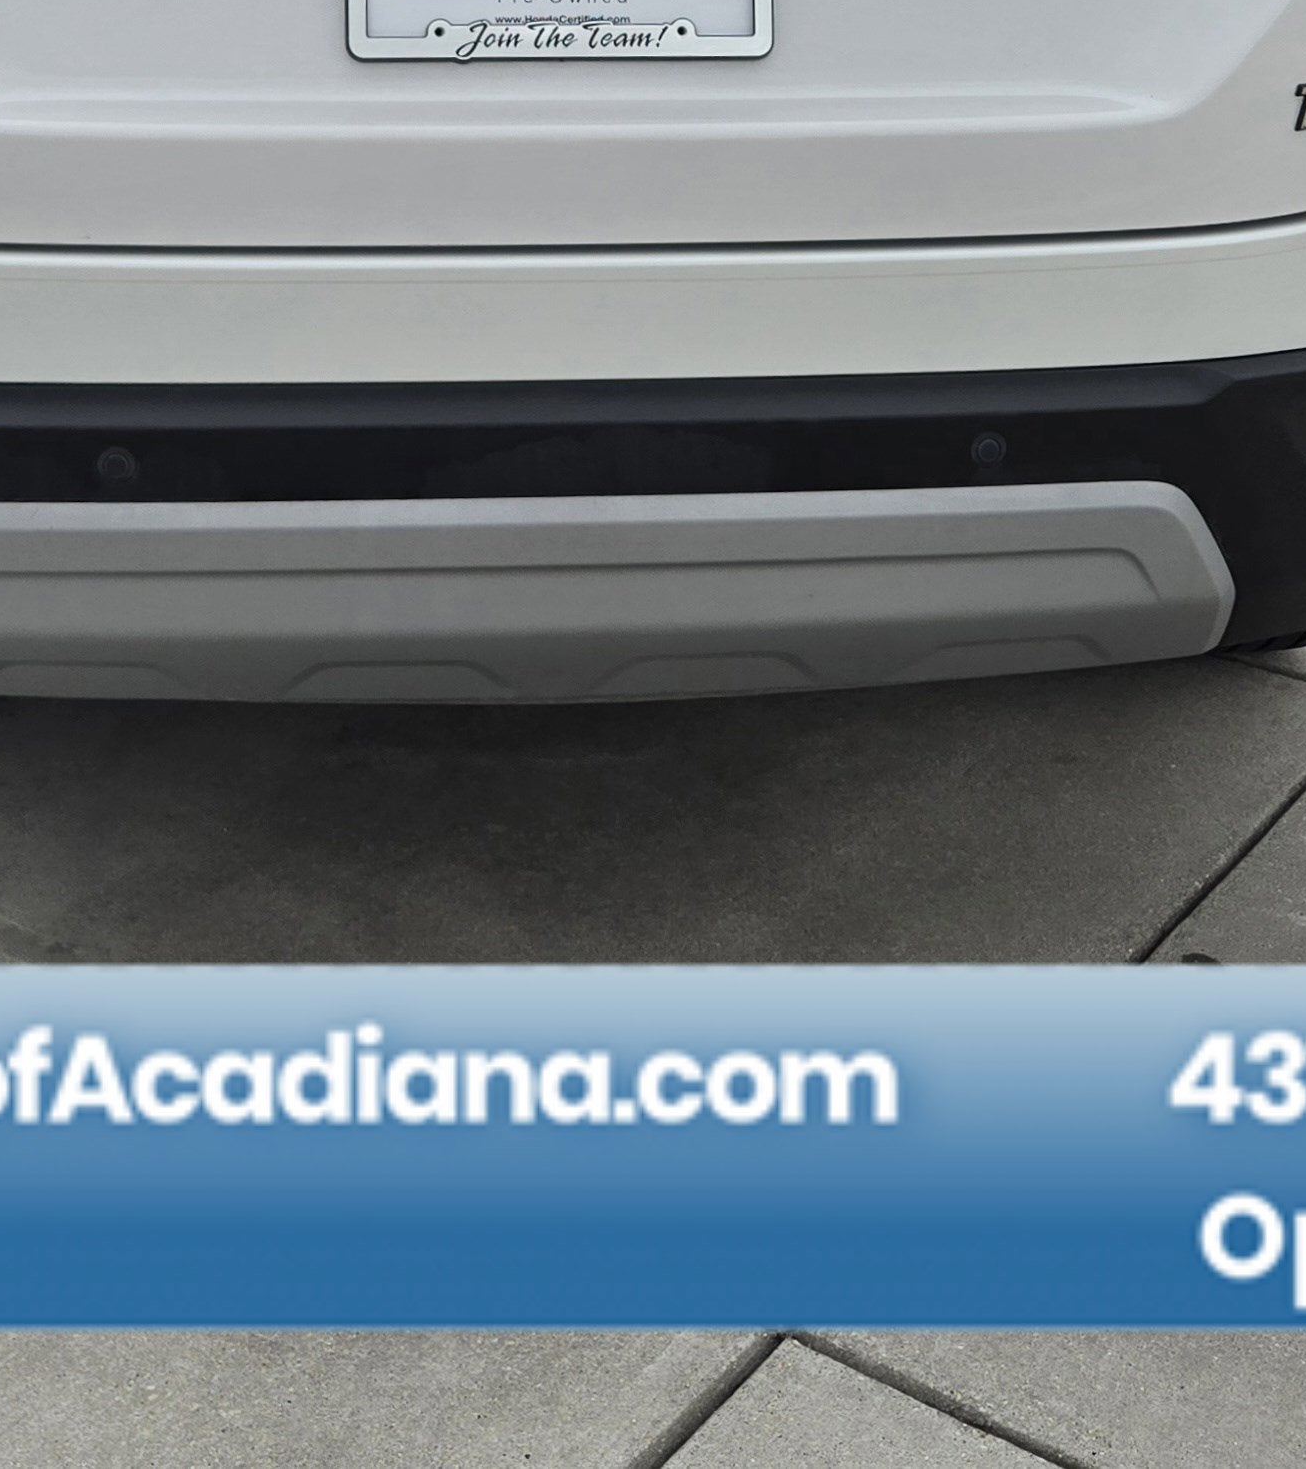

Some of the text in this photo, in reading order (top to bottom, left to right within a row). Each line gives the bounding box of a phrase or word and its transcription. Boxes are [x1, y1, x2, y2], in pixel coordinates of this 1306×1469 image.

[495, 14, 631, 24] www.HondaCertifiedcom
[455, 22, 669, 58] Join The Team!
